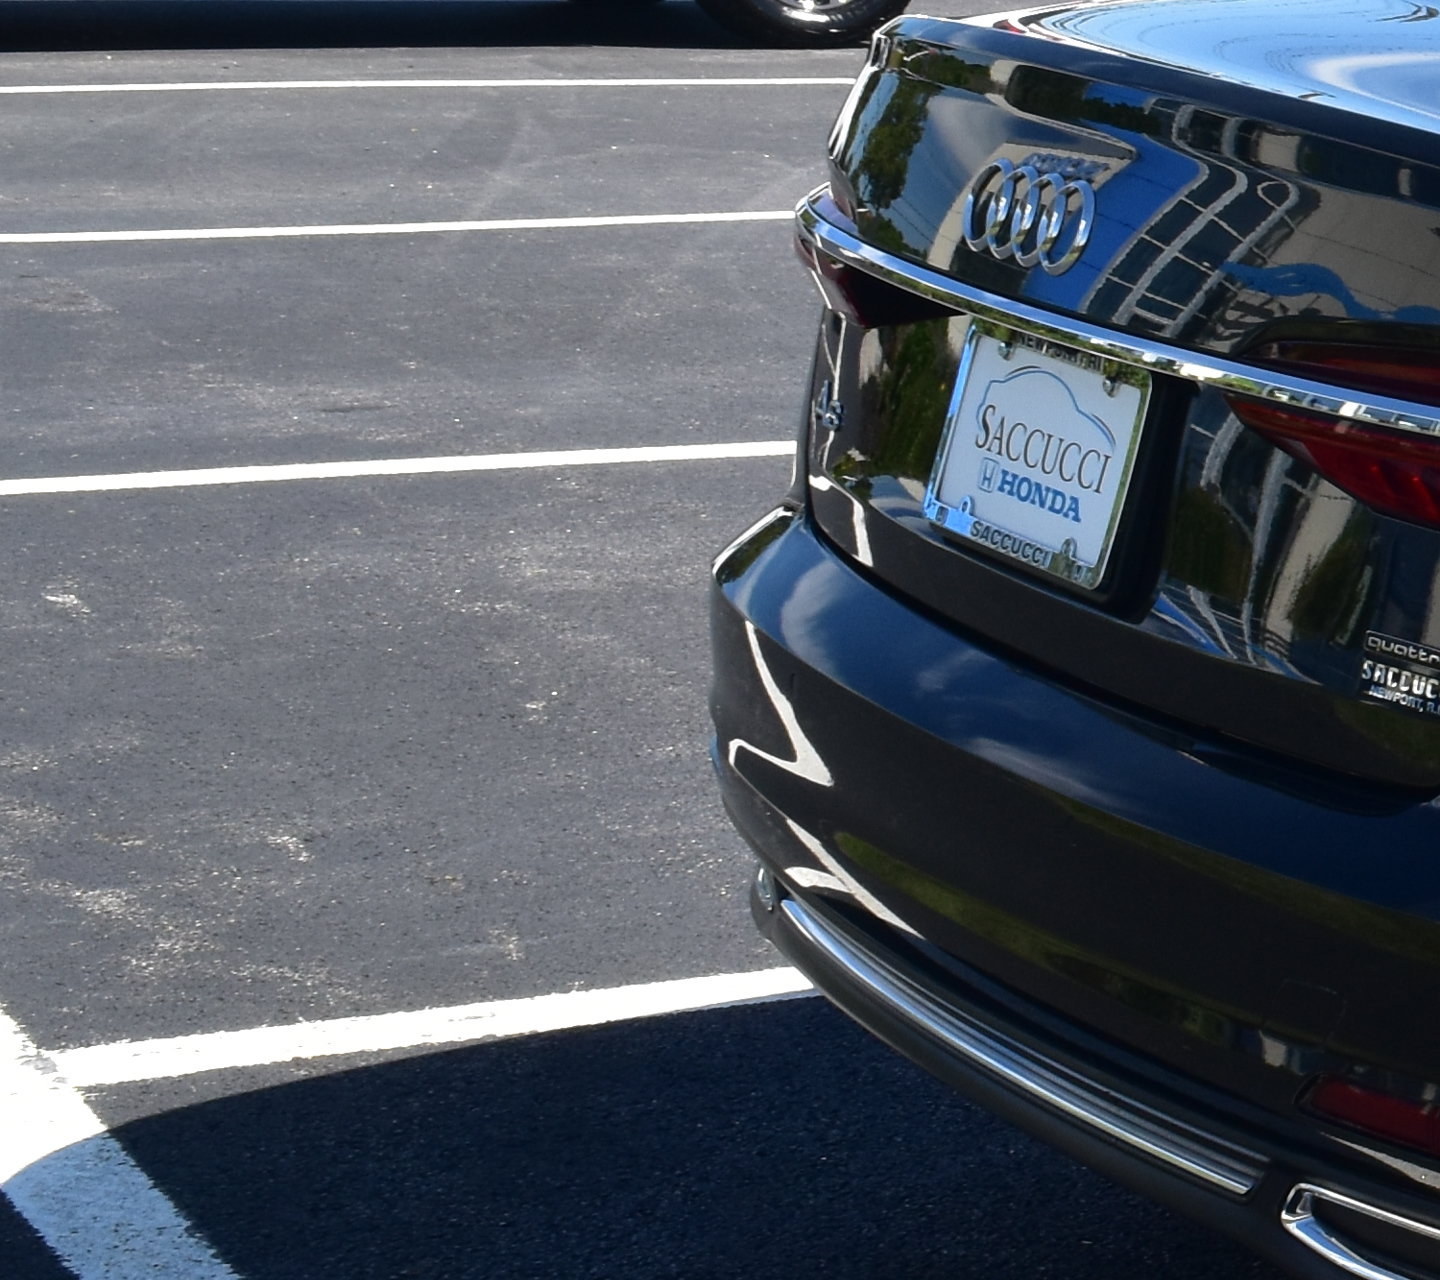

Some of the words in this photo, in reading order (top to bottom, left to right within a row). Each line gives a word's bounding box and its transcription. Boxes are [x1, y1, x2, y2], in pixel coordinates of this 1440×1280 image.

[975, 404, 1113, 494] SACCUCCI
[997, 469, 1082, 523] HONDA
[969, 520, 1050, 565] SACCUCCI
